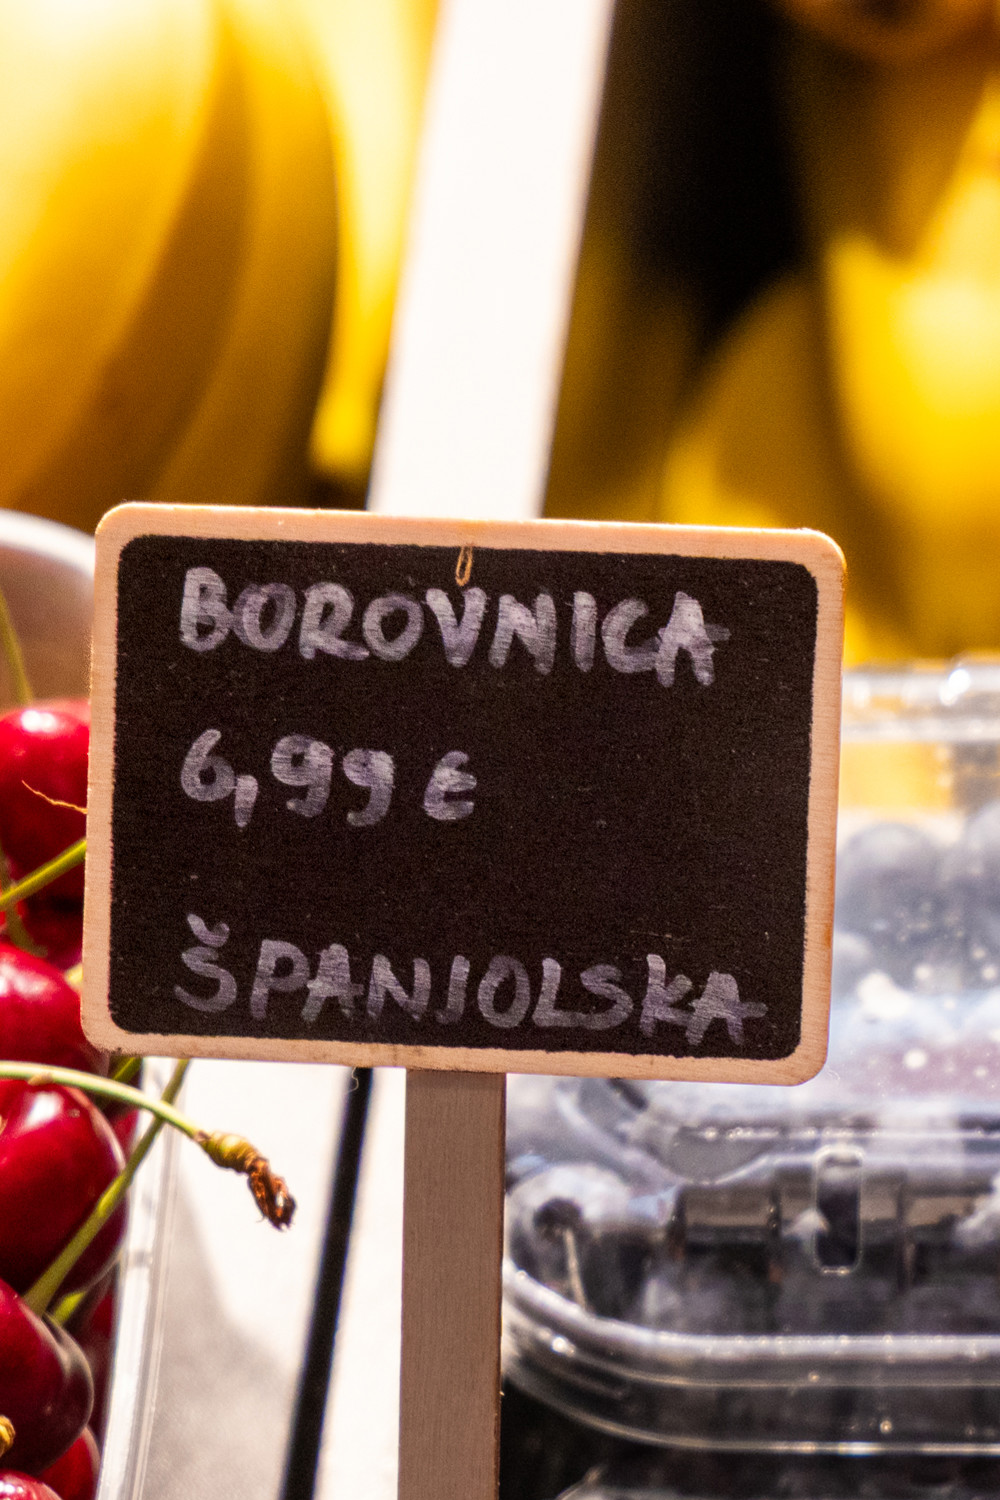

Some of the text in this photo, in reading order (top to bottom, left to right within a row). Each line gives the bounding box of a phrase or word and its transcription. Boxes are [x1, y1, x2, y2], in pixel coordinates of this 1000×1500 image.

[178, 567, 731, 688] BOROVNICA
[180, 728, 478, 828] 6,99 €
